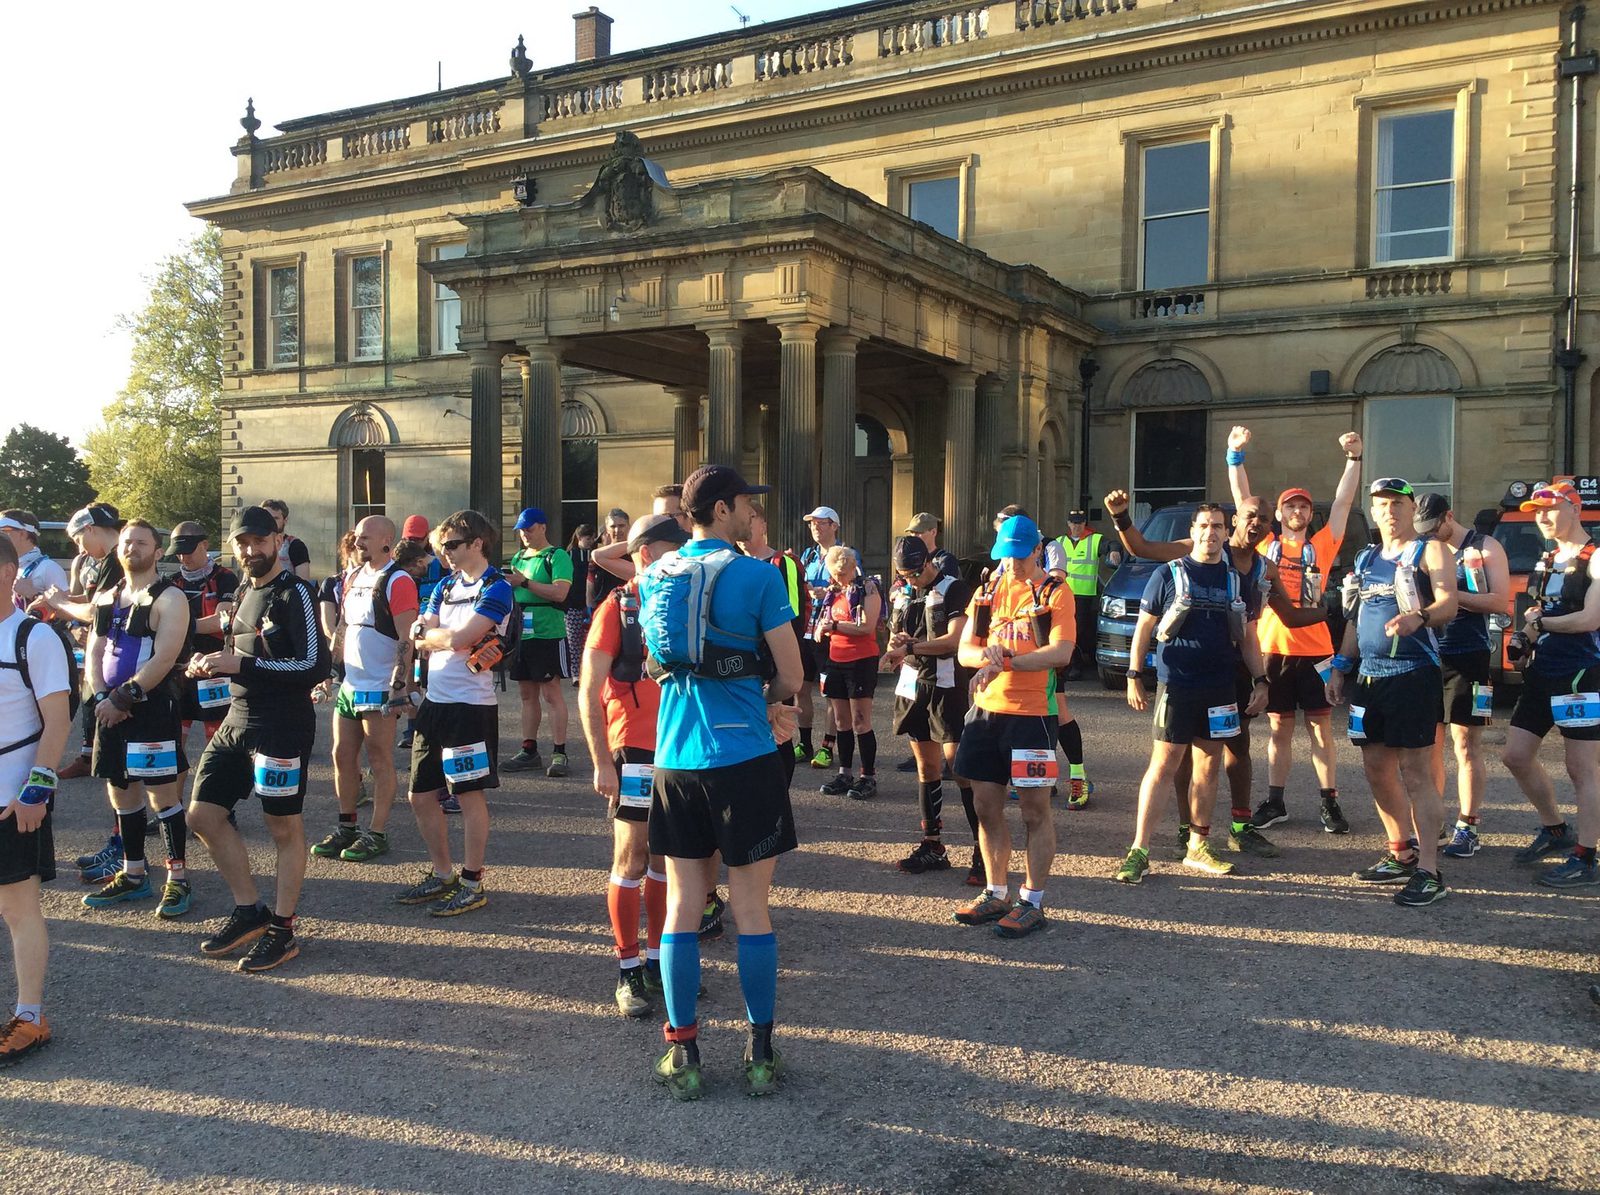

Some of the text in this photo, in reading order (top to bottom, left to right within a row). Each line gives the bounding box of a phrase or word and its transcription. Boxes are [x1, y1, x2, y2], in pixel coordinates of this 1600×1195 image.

[1580, 478, 1598, 489] G4
[208, 686, 224, 700] 51
[1565, 703, 1586, 719] 43
[144, 753, 156, 768] 2
[453, 755, 475, 773] 58
[1026, 761, 1047, 778] 66
[265, 770, 289, 787] 60
